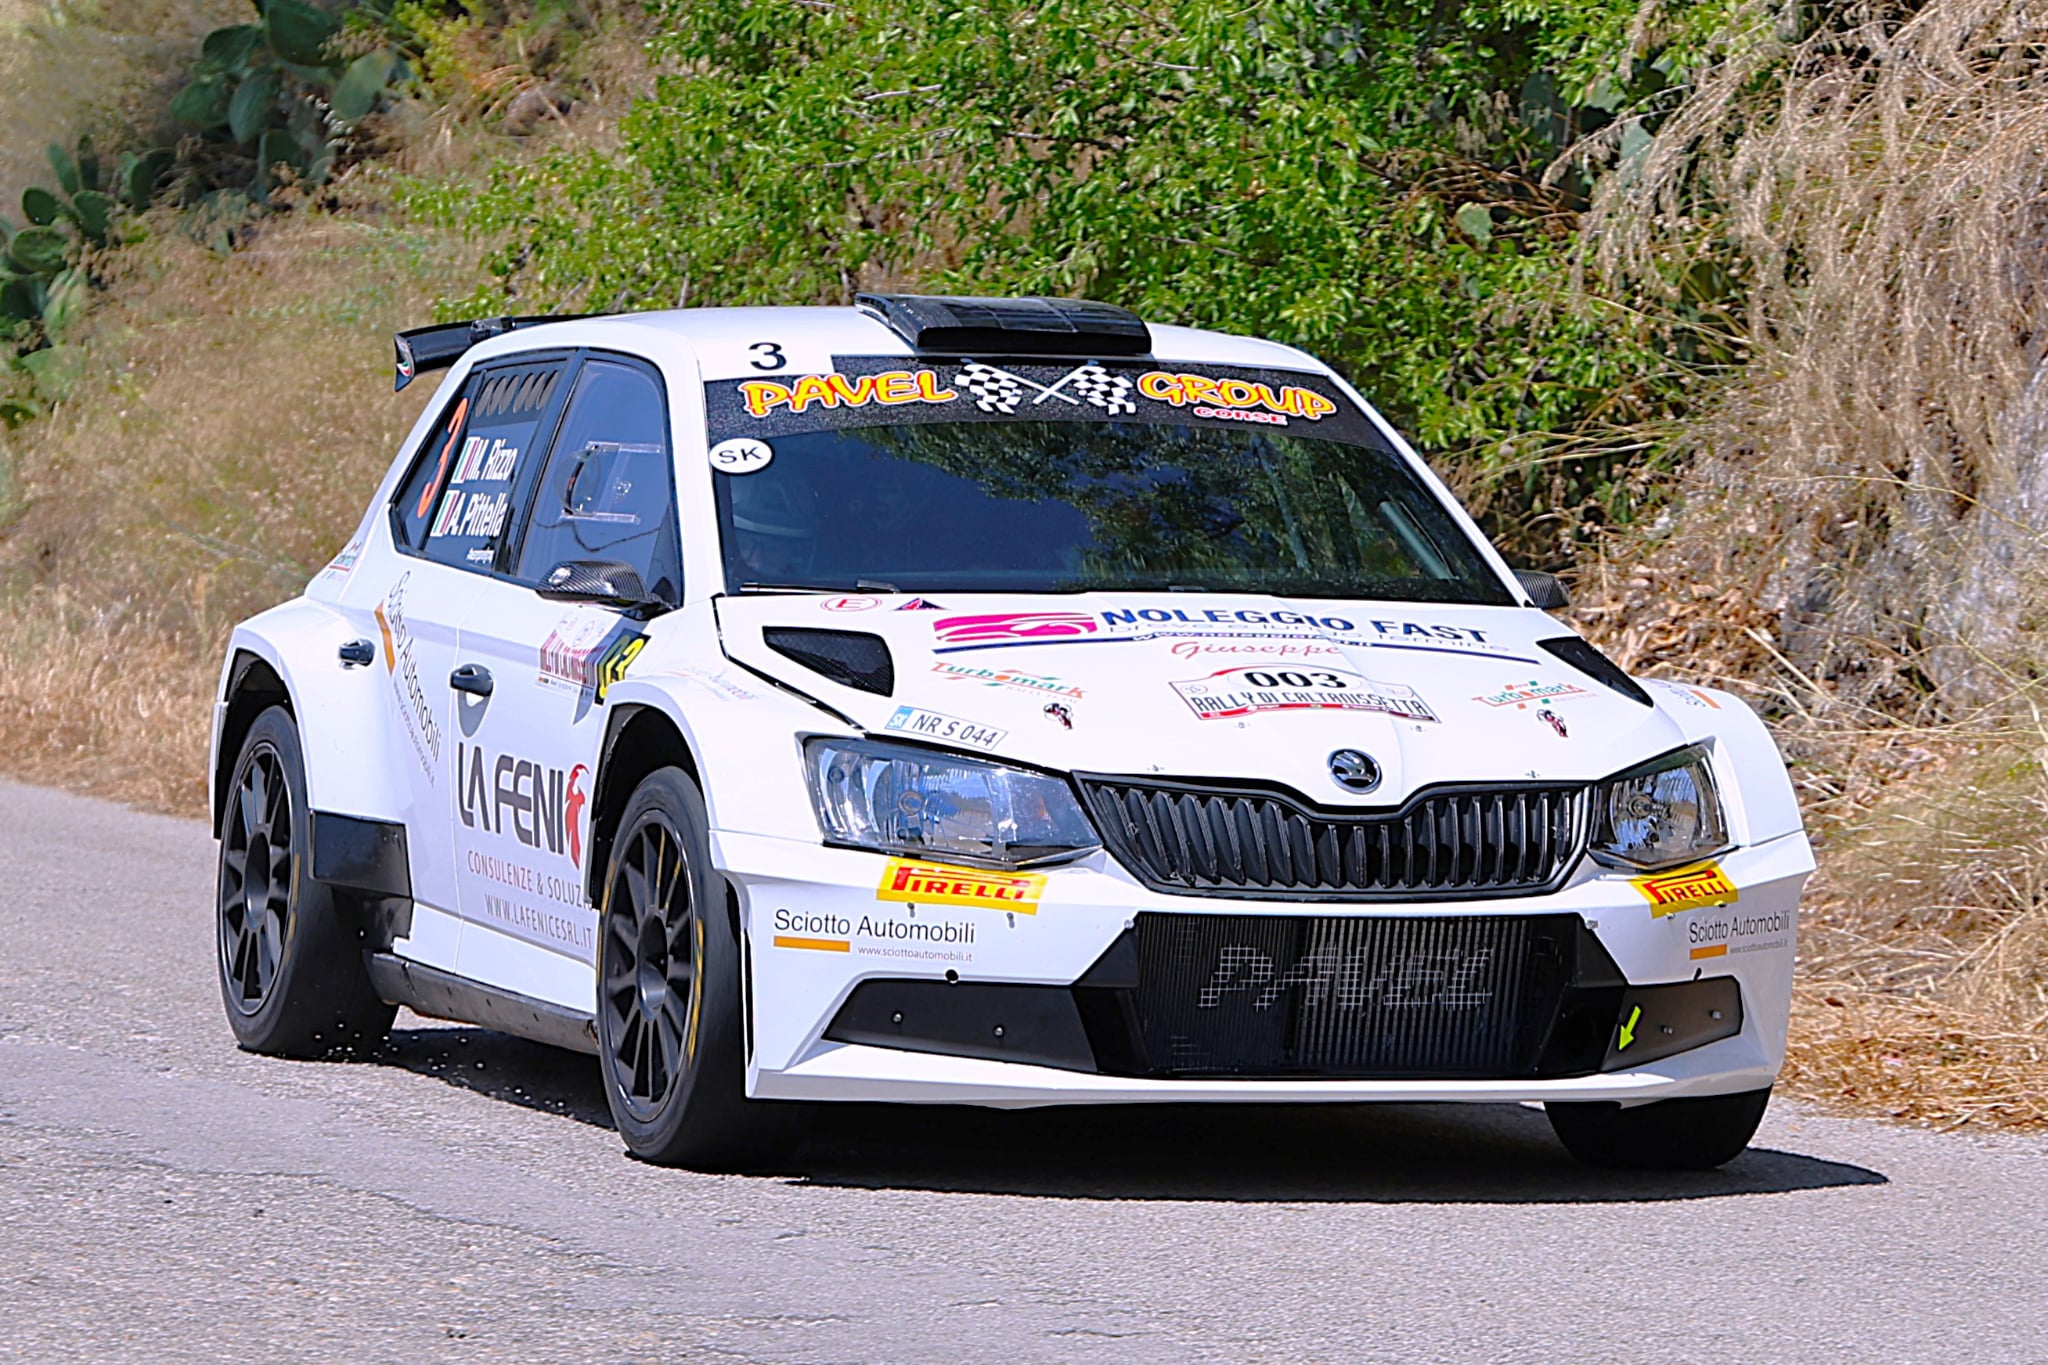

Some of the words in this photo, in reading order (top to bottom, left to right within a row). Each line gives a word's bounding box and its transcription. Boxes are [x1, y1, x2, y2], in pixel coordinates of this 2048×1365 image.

[749, 342, 787, 371] 3
[740, 370, 958, 417] PAVEL
[1138, 372, 1336, 419] GROUP
[1194, 407, 1288, 426] CORSE
[417, 397, 469, 519] 3
[480, 438, 518, 481] Rizzo
[718, 446, 763, 464] SK
[1100, 608, 1355, 632] NOLEGGIO
[1369, 619, 1488, 644] FAST
[399, 636, 442, 763] Automobili
[1243, 671, 1347, 693] 003
[1191, 691, 1255, 712] RALLY
[1257, 691, 1279, 704] DI
[1281, 690, 1430, 716] CALTANISSETTA
[912, 713, 943, 734] NR
[942, 721, 961, 737] S
[959, 725, 999, 746] 044
[457, 741, 491, 832] LA
[467, 850, 533, 893] CONSULENZE
[537, 872, 544, 895] &
[890, 865, 1032, 901] PIRELLI
[1642, 868, 1729, 905] PIRELLI
[484, 893, 593, 950] WWW.LAFENICESRL.IT
[774, 909, 851, 936] Sciotto
[857, 915, 975, 944] Automobili
[1688, 918, 1729, 944] Sciotto
[1729, 911, 1791, 938] Automobili
[858, 945, 973, 962] www.sciottoautomobili.it
